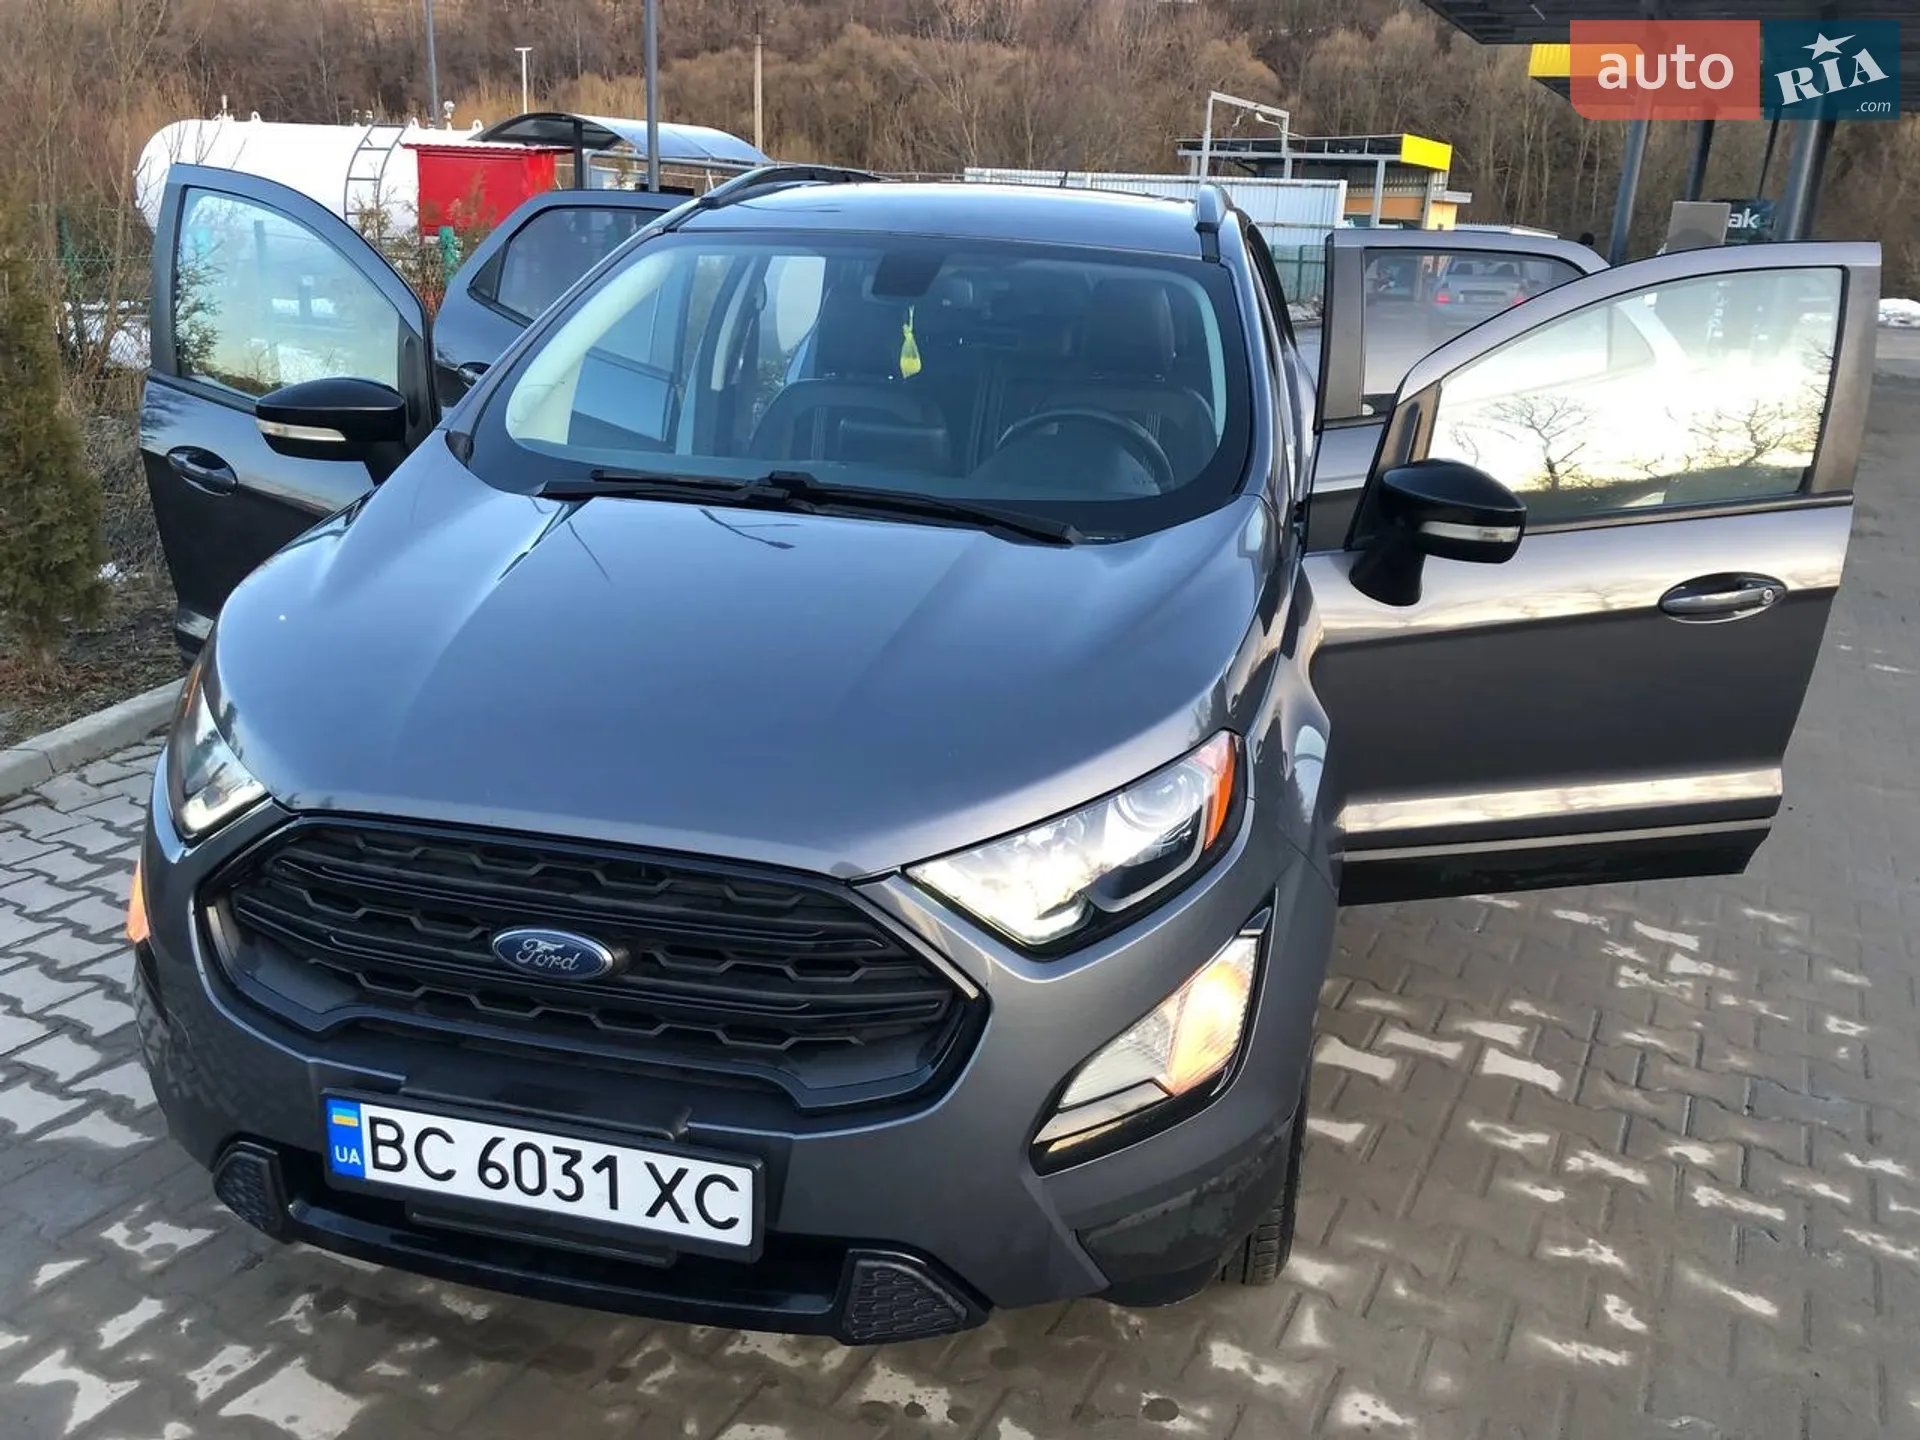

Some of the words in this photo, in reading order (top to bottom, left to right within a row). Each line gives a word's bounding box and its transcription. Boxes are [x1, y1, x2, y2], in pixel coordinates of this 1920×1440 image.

[1728, 208, 1760, 229] ak
[517, 939, 580, 970] Ford
[335, 1146, 361, 1166] UA
[369, 1117, 456, 1182] BC
[477, 1137, 618, 1210] 6031
[645, 1162, 739, 1230] XC
